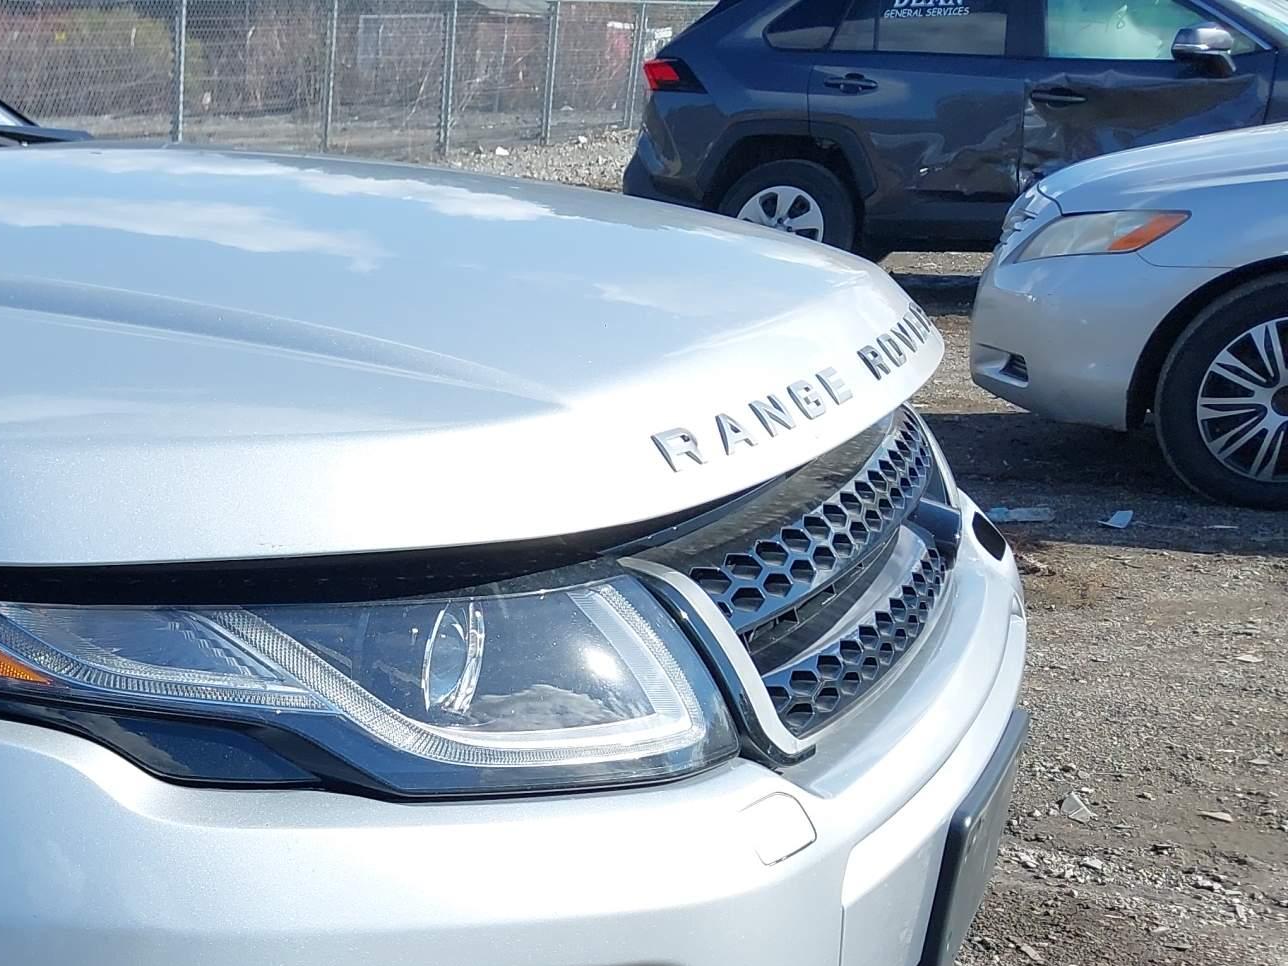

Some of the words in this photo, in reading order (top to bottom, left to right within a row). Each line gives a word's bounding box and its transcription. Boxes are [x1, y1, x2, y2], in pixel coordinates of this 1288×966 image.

[884, 8, 923, 18] GENERAL
[925, 6, 971, 17] SERVICES
[650, 366, 854, 473] RANGE
